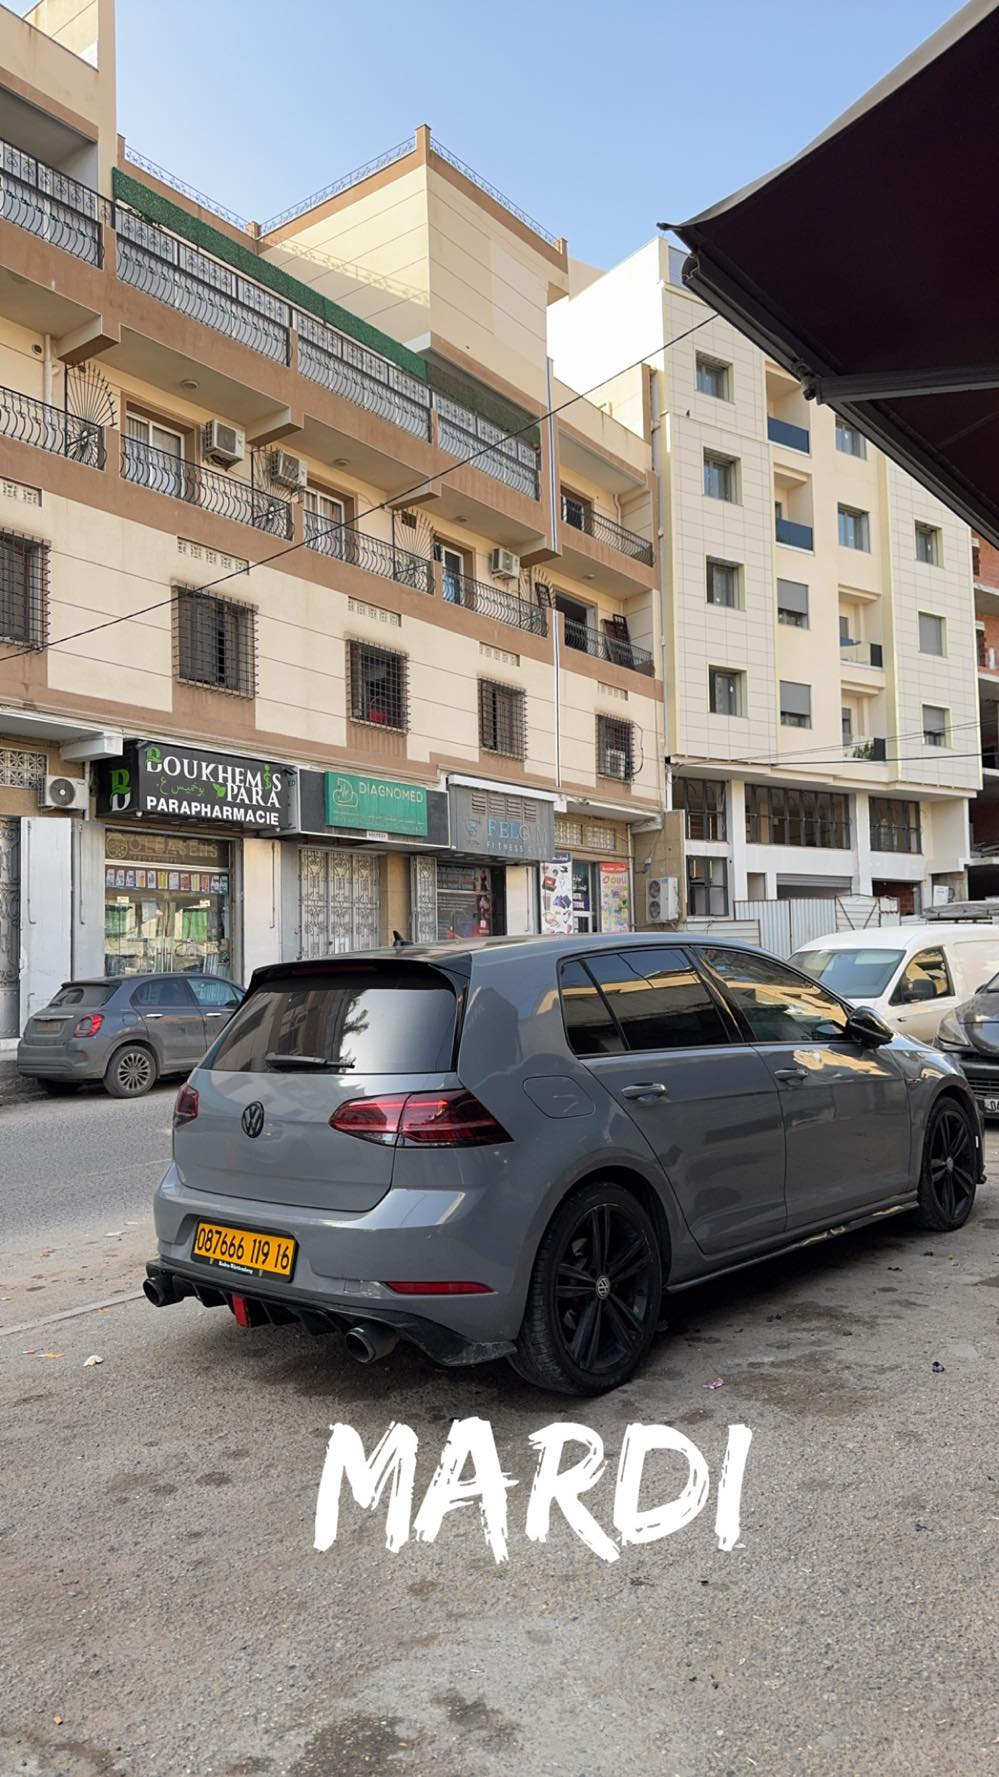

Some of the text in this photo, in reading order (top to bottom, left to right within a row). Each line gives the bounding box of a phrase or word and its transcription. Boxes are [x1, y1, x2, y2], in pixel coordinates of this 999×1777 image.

[226, 783, 281, 808] PARA
[359, 782, 424, 803] DIAGNOMED
[146, 796, 280, 826] PARAPHARMACIE
[197, 1228, 290, 1270] 087666 119 16
